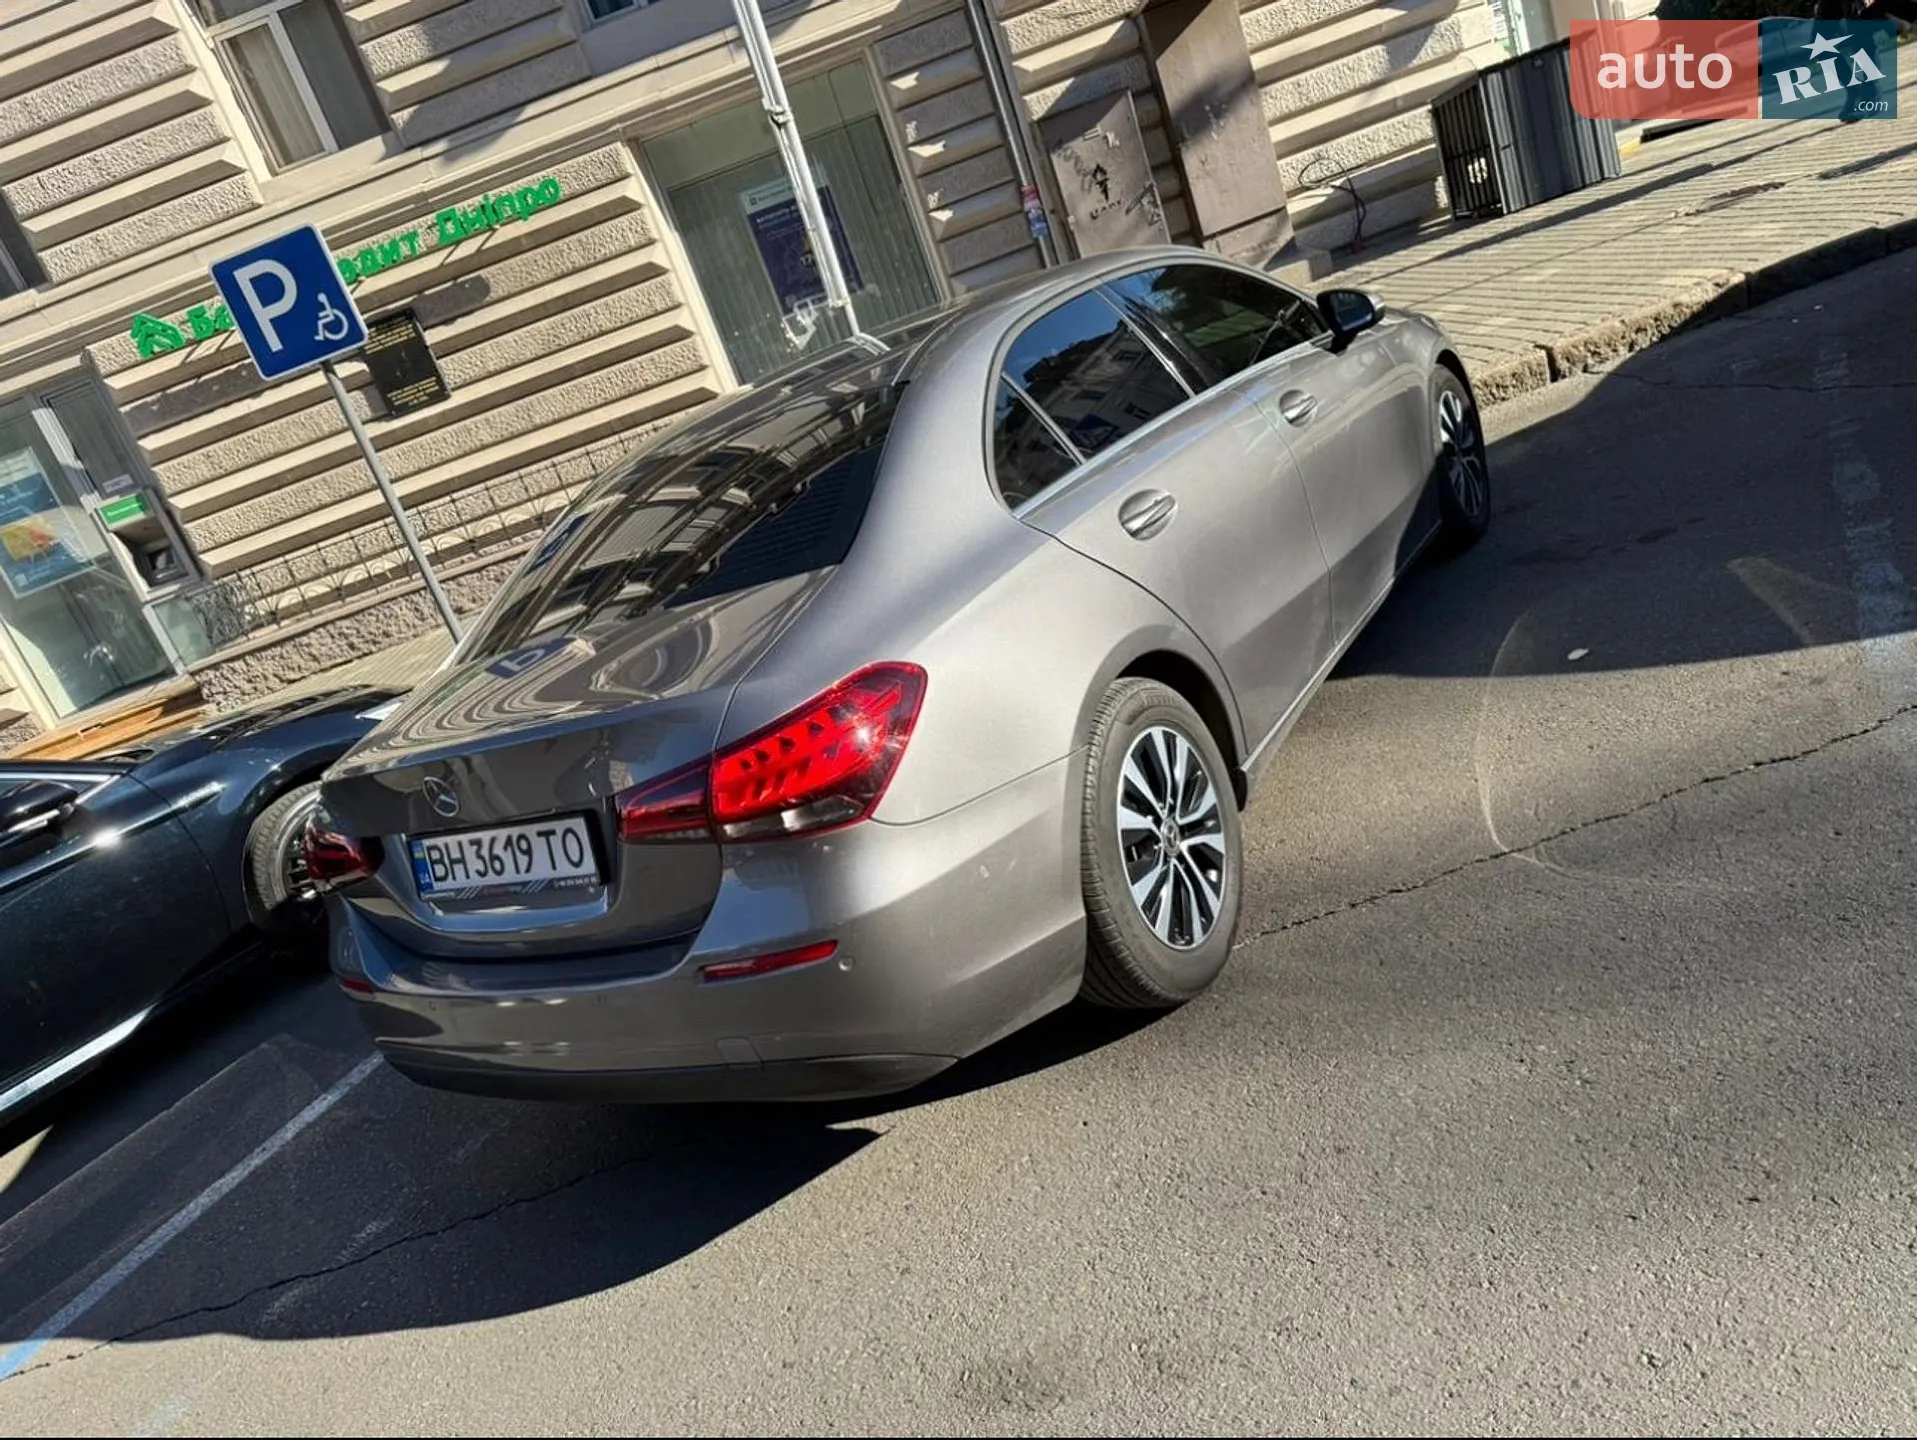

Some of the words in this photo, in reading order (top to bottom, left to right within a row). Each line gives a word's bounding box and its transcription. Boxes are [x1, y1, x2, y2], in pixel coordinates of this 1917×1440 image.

[186, 304, 236, 341] Ба
[434, 176, 563, 246] Дніпро
[233, 259, 297, 352] P
